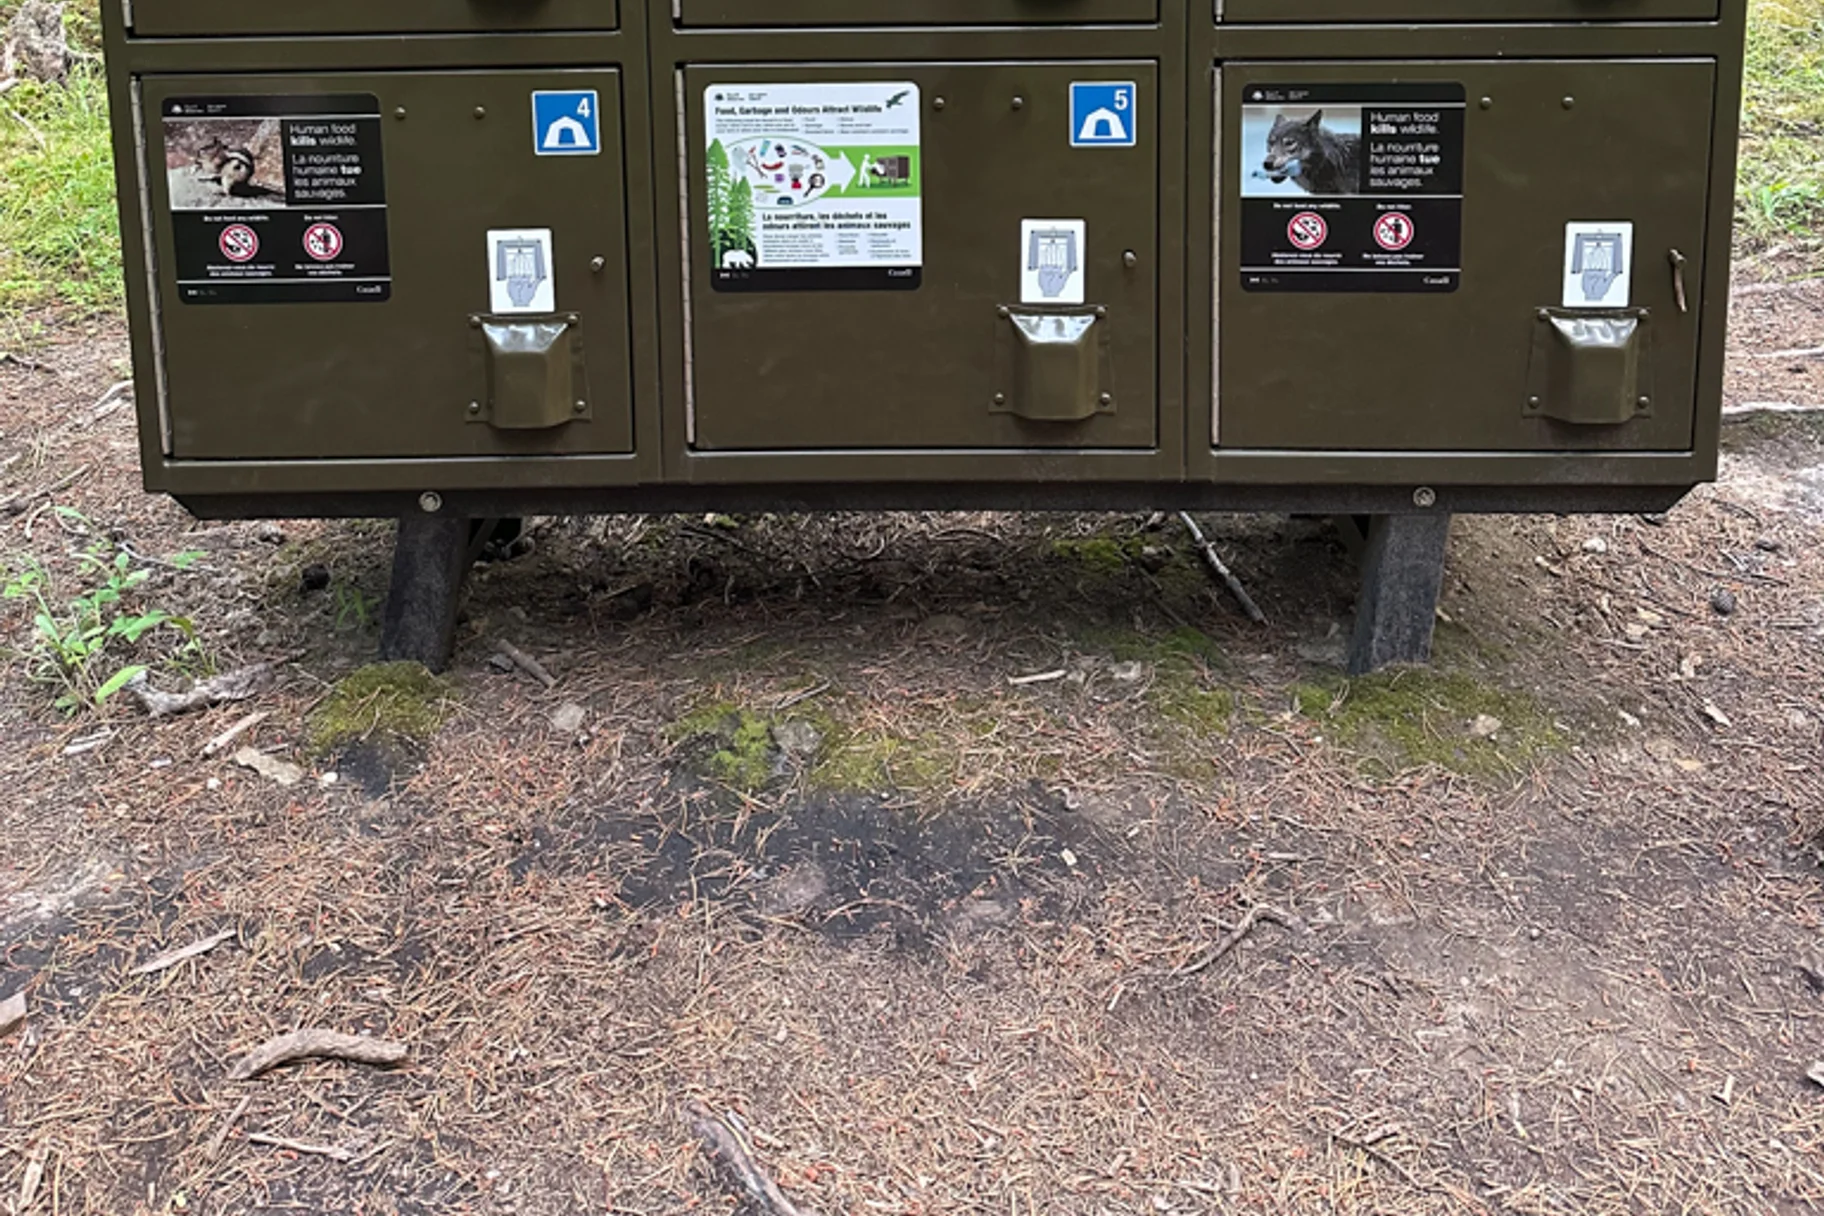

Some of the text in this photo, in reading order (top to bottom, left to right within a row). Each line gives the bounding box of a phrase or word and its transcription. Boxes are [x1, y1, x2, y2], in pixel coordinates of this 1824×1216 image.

[1114, 90, 1128, 110] 5
[577, 98, 590, 118] 4
[715, 105, 882, 116] Food, Garbage and Odours Attract Wildlife
[1370, 112, 1439, 122] Human food
[290, 124, 355, 134] Human food
[1371, 124, 1439, 134] kills wildlife.
[290, 136, 356, 146] kills wildlife.
[1371, 142, 1439, 153] La nourriture
[293, 153, 359, 164] La nourriture
[1370, 154, 1440, 164] humaine tue
[293, 165, 361, 175] humaine tue
[1370, 165, 1433, 175] les animaux
[295, 176, 356, 186] les animaux
[1370, 178, 1422, 188] sauvages.
[295, 189, 346, 200] sauvages.
